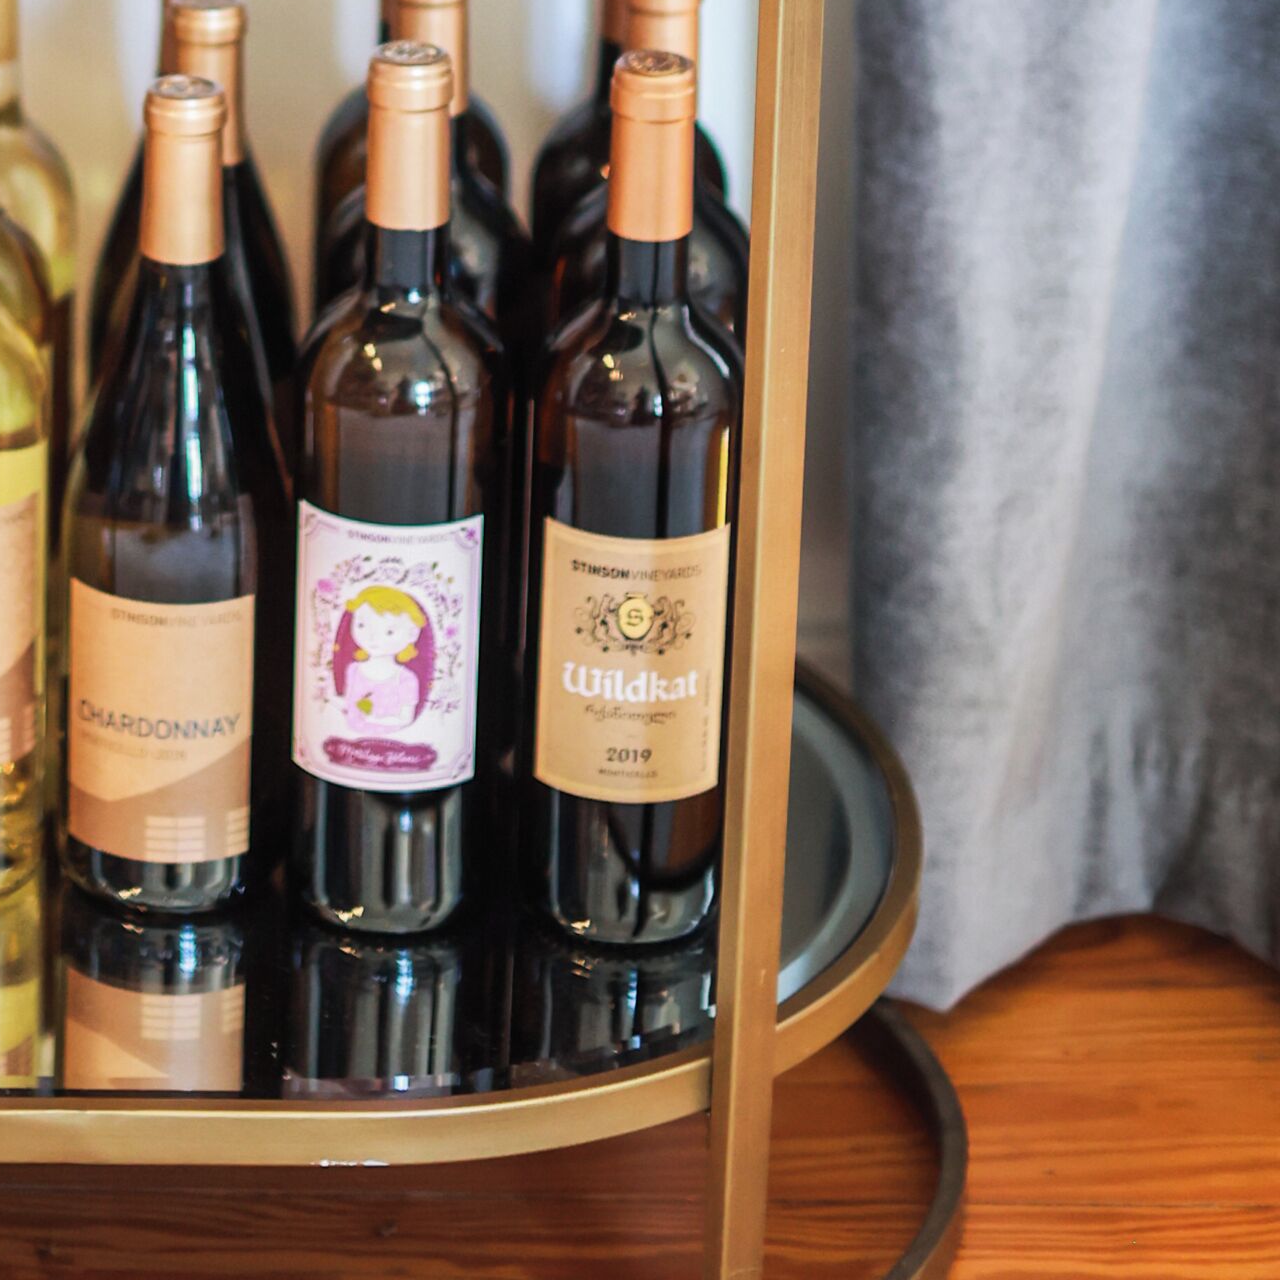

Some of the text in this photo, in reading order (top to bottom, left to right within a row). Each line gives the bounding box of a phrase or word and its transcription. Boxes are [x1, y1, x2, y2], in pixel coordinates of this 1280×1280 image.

[561, 660, 700, 704] Wildkat
[78, 699, 241, 740] CHARDONNAY
[606, 747, 653, 763] 2019
